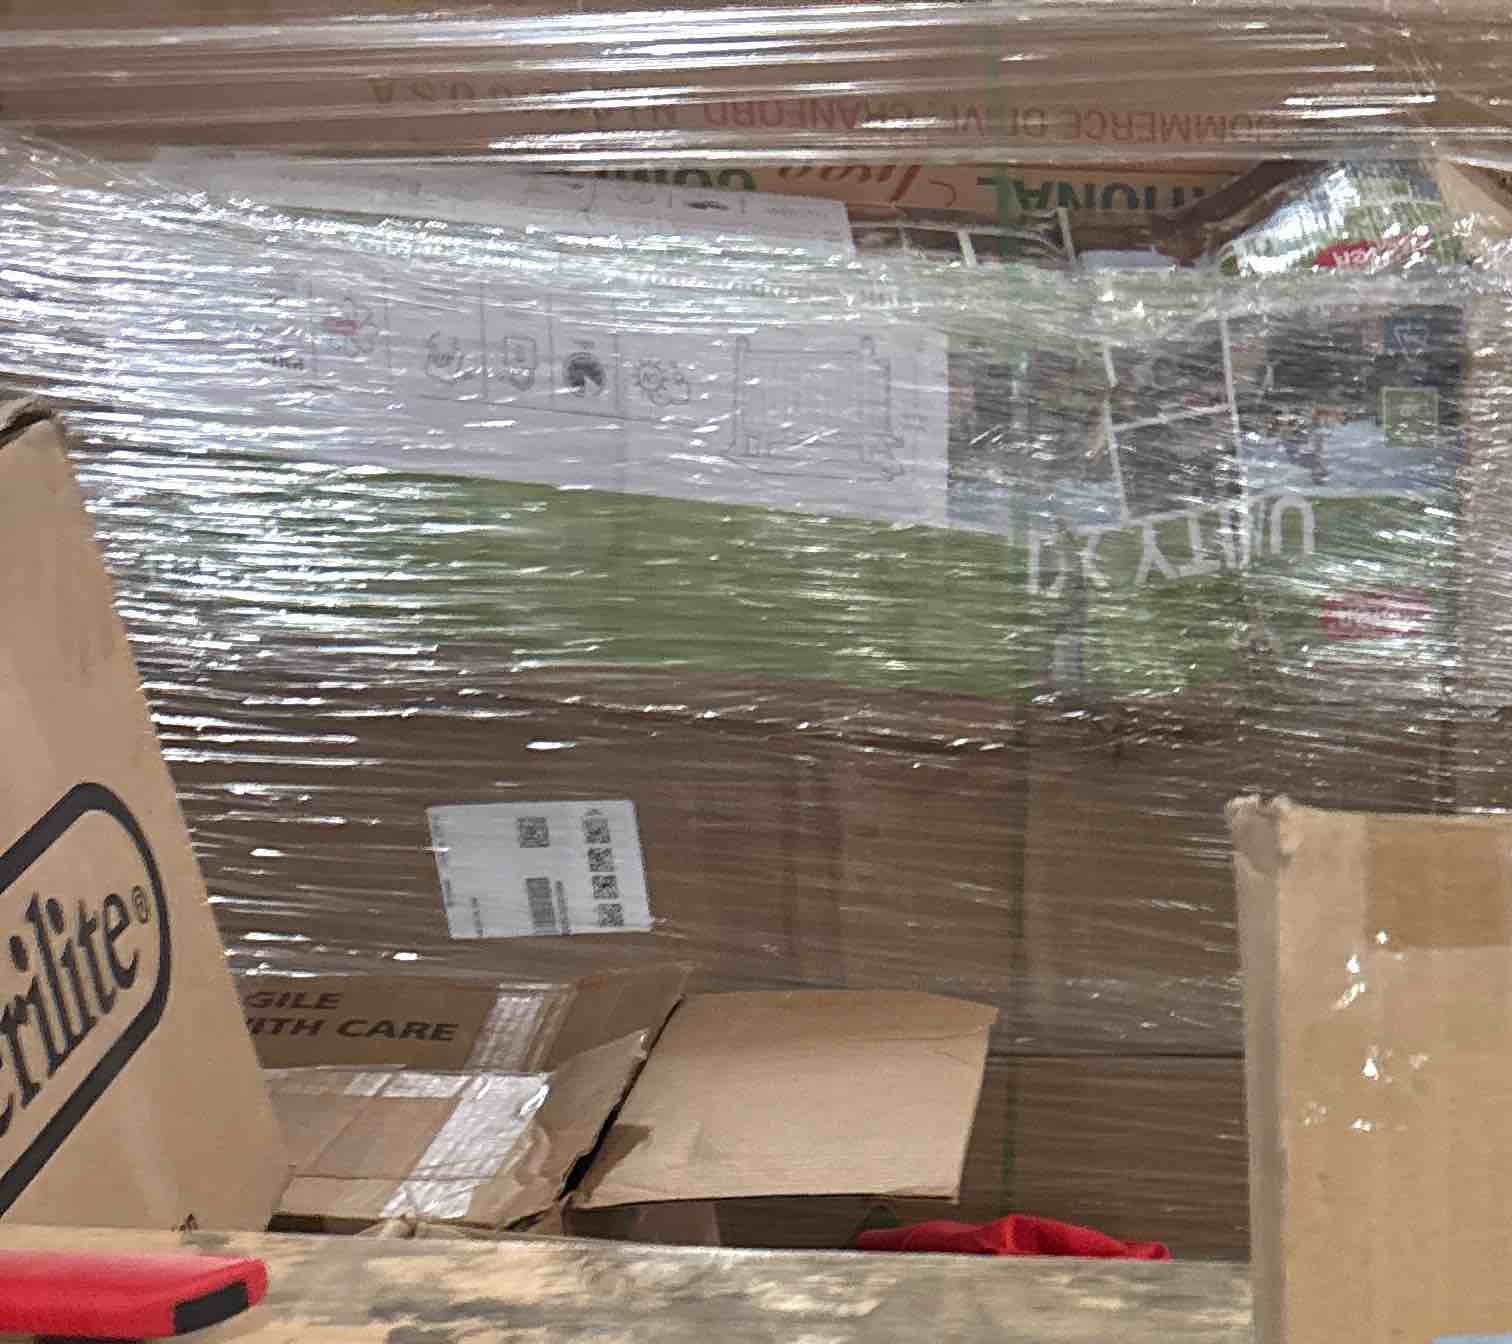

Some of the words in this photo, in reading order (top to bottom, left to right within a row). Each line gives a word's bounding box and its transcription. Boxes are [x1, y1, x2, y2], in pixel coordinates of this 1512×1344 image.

[246, 991, 343, 1010] GILE
[246, 1016, 327, 1038] ITH
[336, 1019, 459, 1041] CARE
